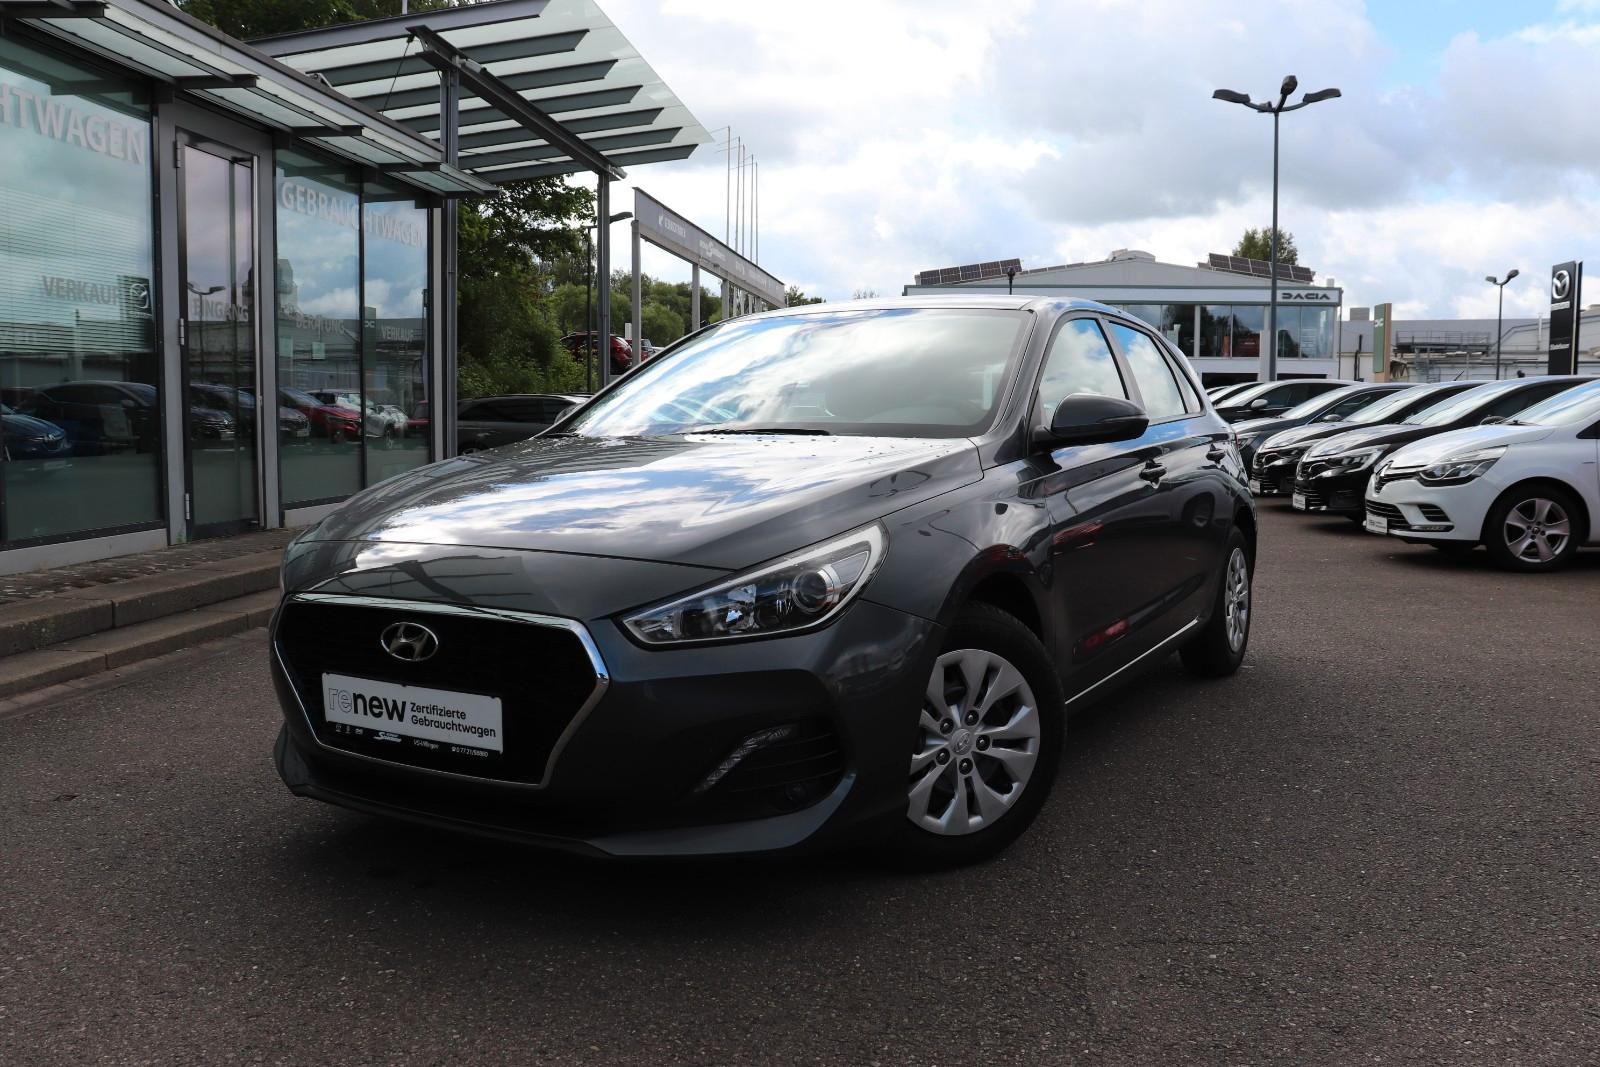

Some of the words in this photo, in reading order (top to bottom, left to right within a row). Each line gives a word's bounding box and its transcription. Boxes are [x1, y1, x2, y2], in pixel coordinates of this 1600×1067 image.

[281, 181, 424, 247] GEBRAUCHTWAGEN
[1281, 292, 1331, 300] DACIA
[327, 687, 407, 722] renew
[410, 702, 467, 720] Zertifizierte
[411, 714, 497, 738] Gebrauchtwagen
